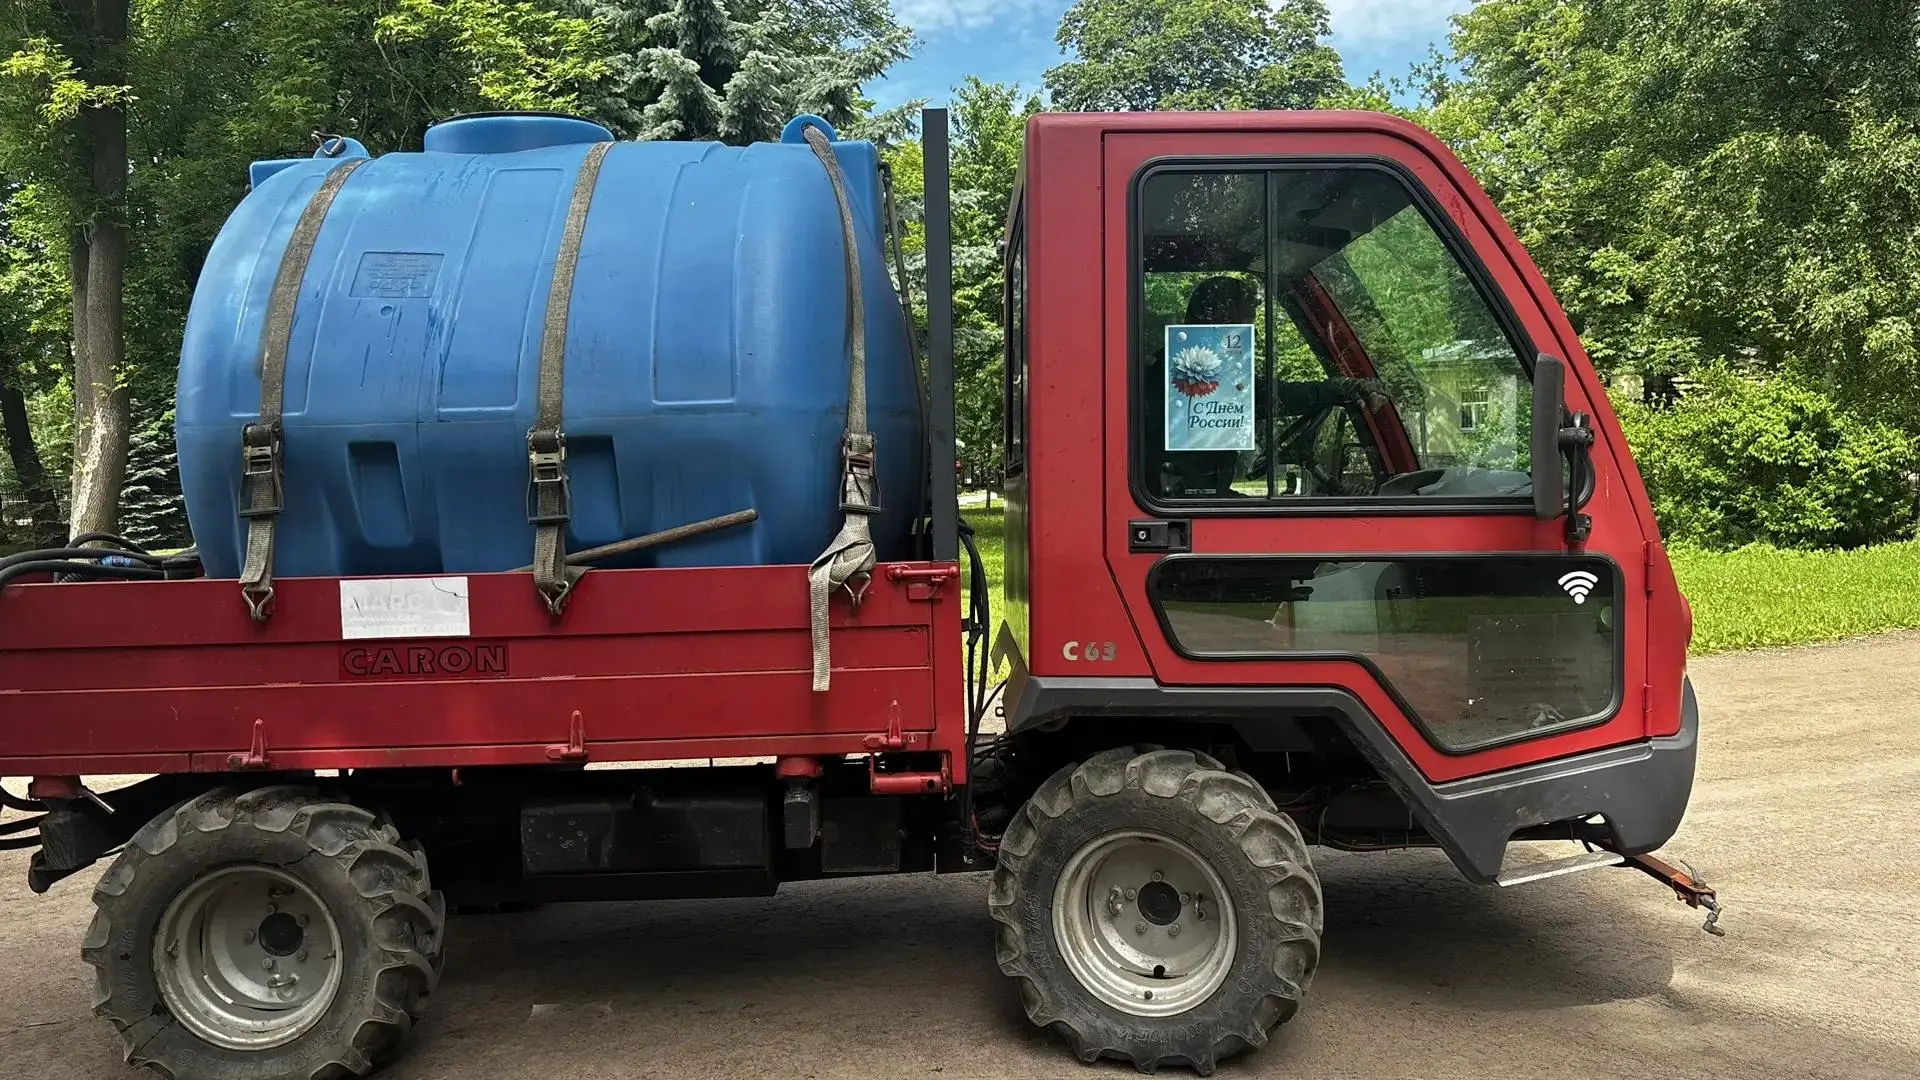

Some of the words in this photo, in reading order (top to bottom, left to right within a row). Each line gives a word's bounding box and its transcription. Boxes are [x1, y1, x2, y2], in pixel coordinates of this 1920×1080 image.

[1226, 335, 1241, 349] 12
[1193, 402, 1204, 414] С
[1205, 401, 1244, 415] Днём
[1188, 416, 1245, 428] России!
[1063, 640, 1079, 661] C
[1084, 641, 1117, 662] 63
[343, 646, 507, 675] CARON
